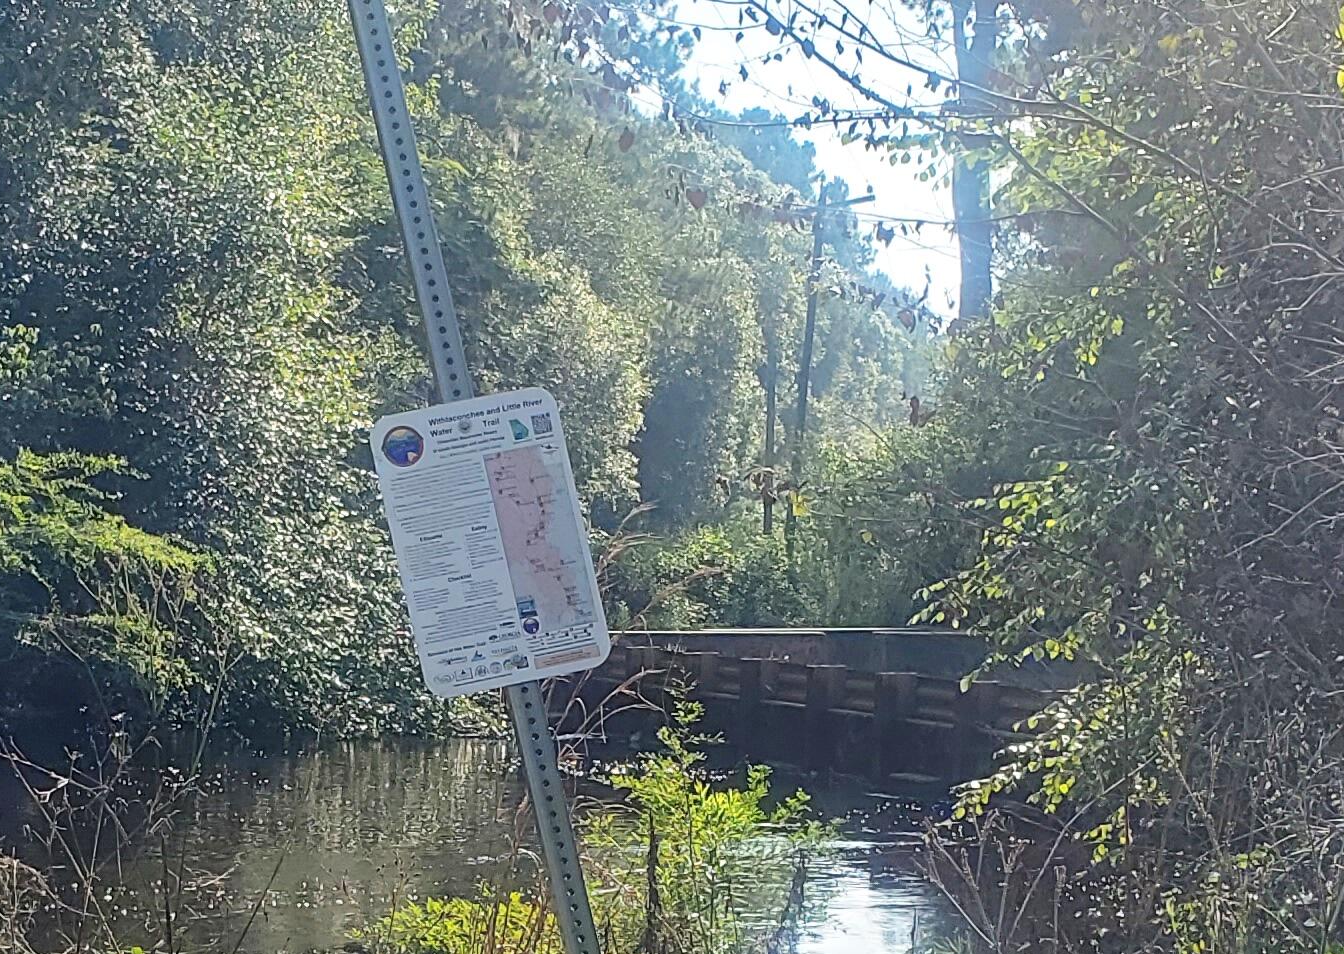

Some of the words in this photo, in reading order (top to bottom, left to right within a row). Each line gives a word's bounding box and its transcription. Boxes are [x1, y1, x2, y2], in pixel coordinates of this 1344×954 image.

[486, 407, 500, 415] and
[502, 402, 521, 412] Little
[523, 399, 542, 408] River
[430, 428, 452, 437] Water
[482, 418, 500, 428] Trail
